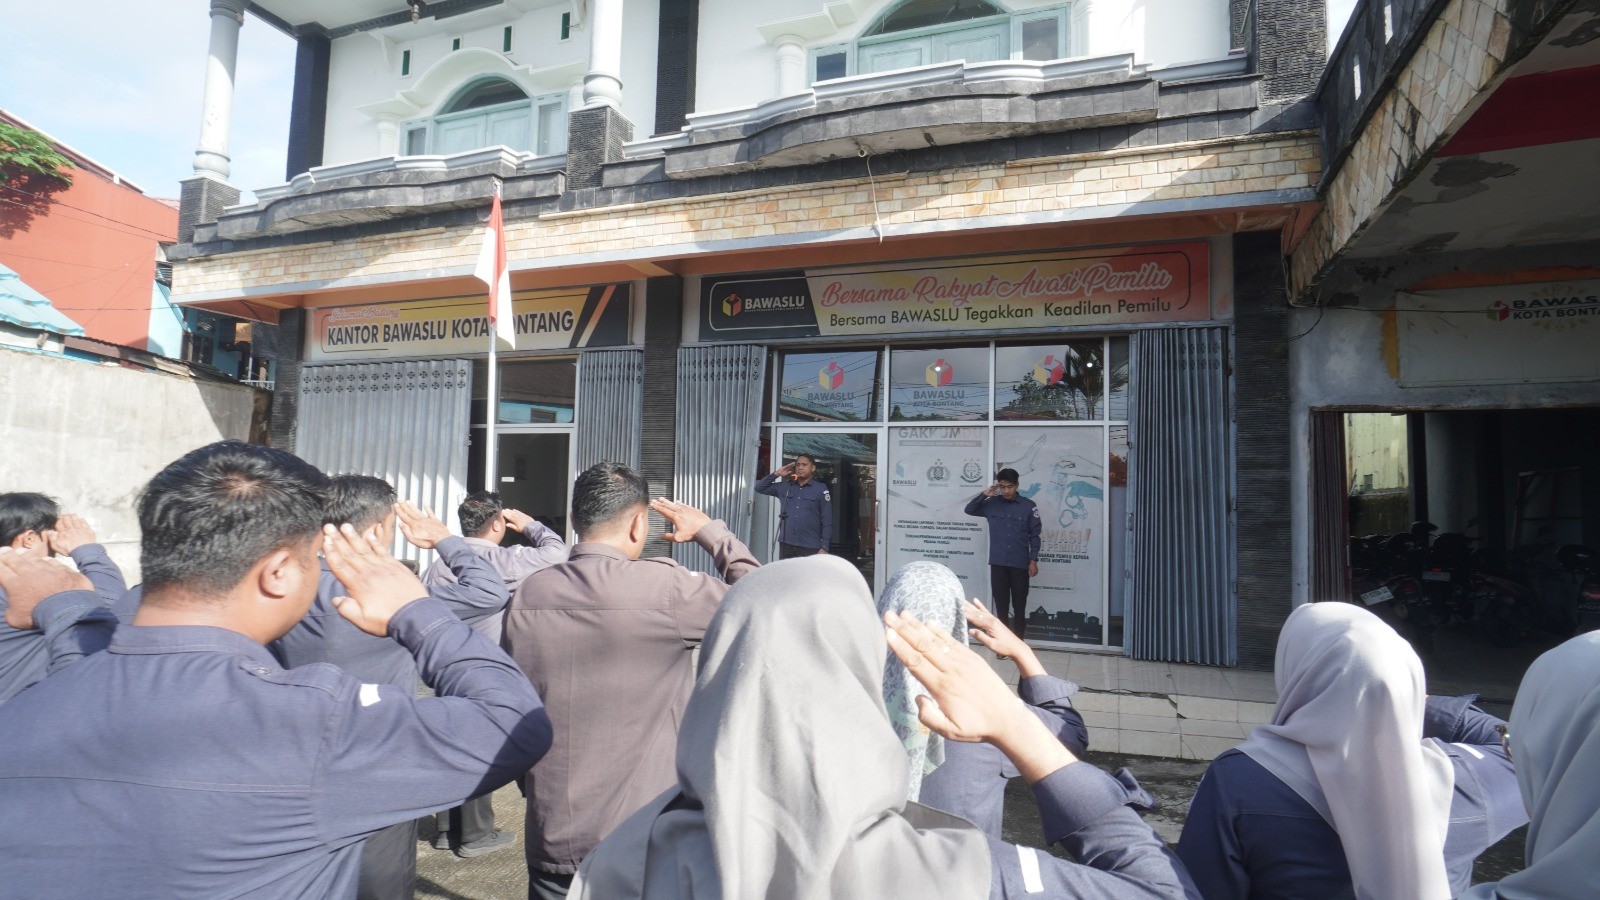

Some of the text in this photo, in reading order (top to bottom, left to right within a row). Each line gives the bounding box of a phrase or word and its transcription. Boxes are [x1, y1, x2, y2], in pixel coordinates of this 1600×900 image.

[821, 262, 1172, 307] Bersama Rakyat Awasi Pemilu
[744, 295, 805, 310] BAWASLU
[1513, 295, 1599, 308] BAWAS
[329, 305, 400, 322] Selamat Datang
[830, 297, 1171, 326] Bersama BAWASLU Tegakkan Keadilan Pemilu
[1513, 310, 1551, 320] KOTA
[327, 310, 574, 346] KANTOR BAWASLU KOTA NTANG
[807, 392, 854, 401] BAWASLU
[913, 390, 965, 400] BAWASLU
